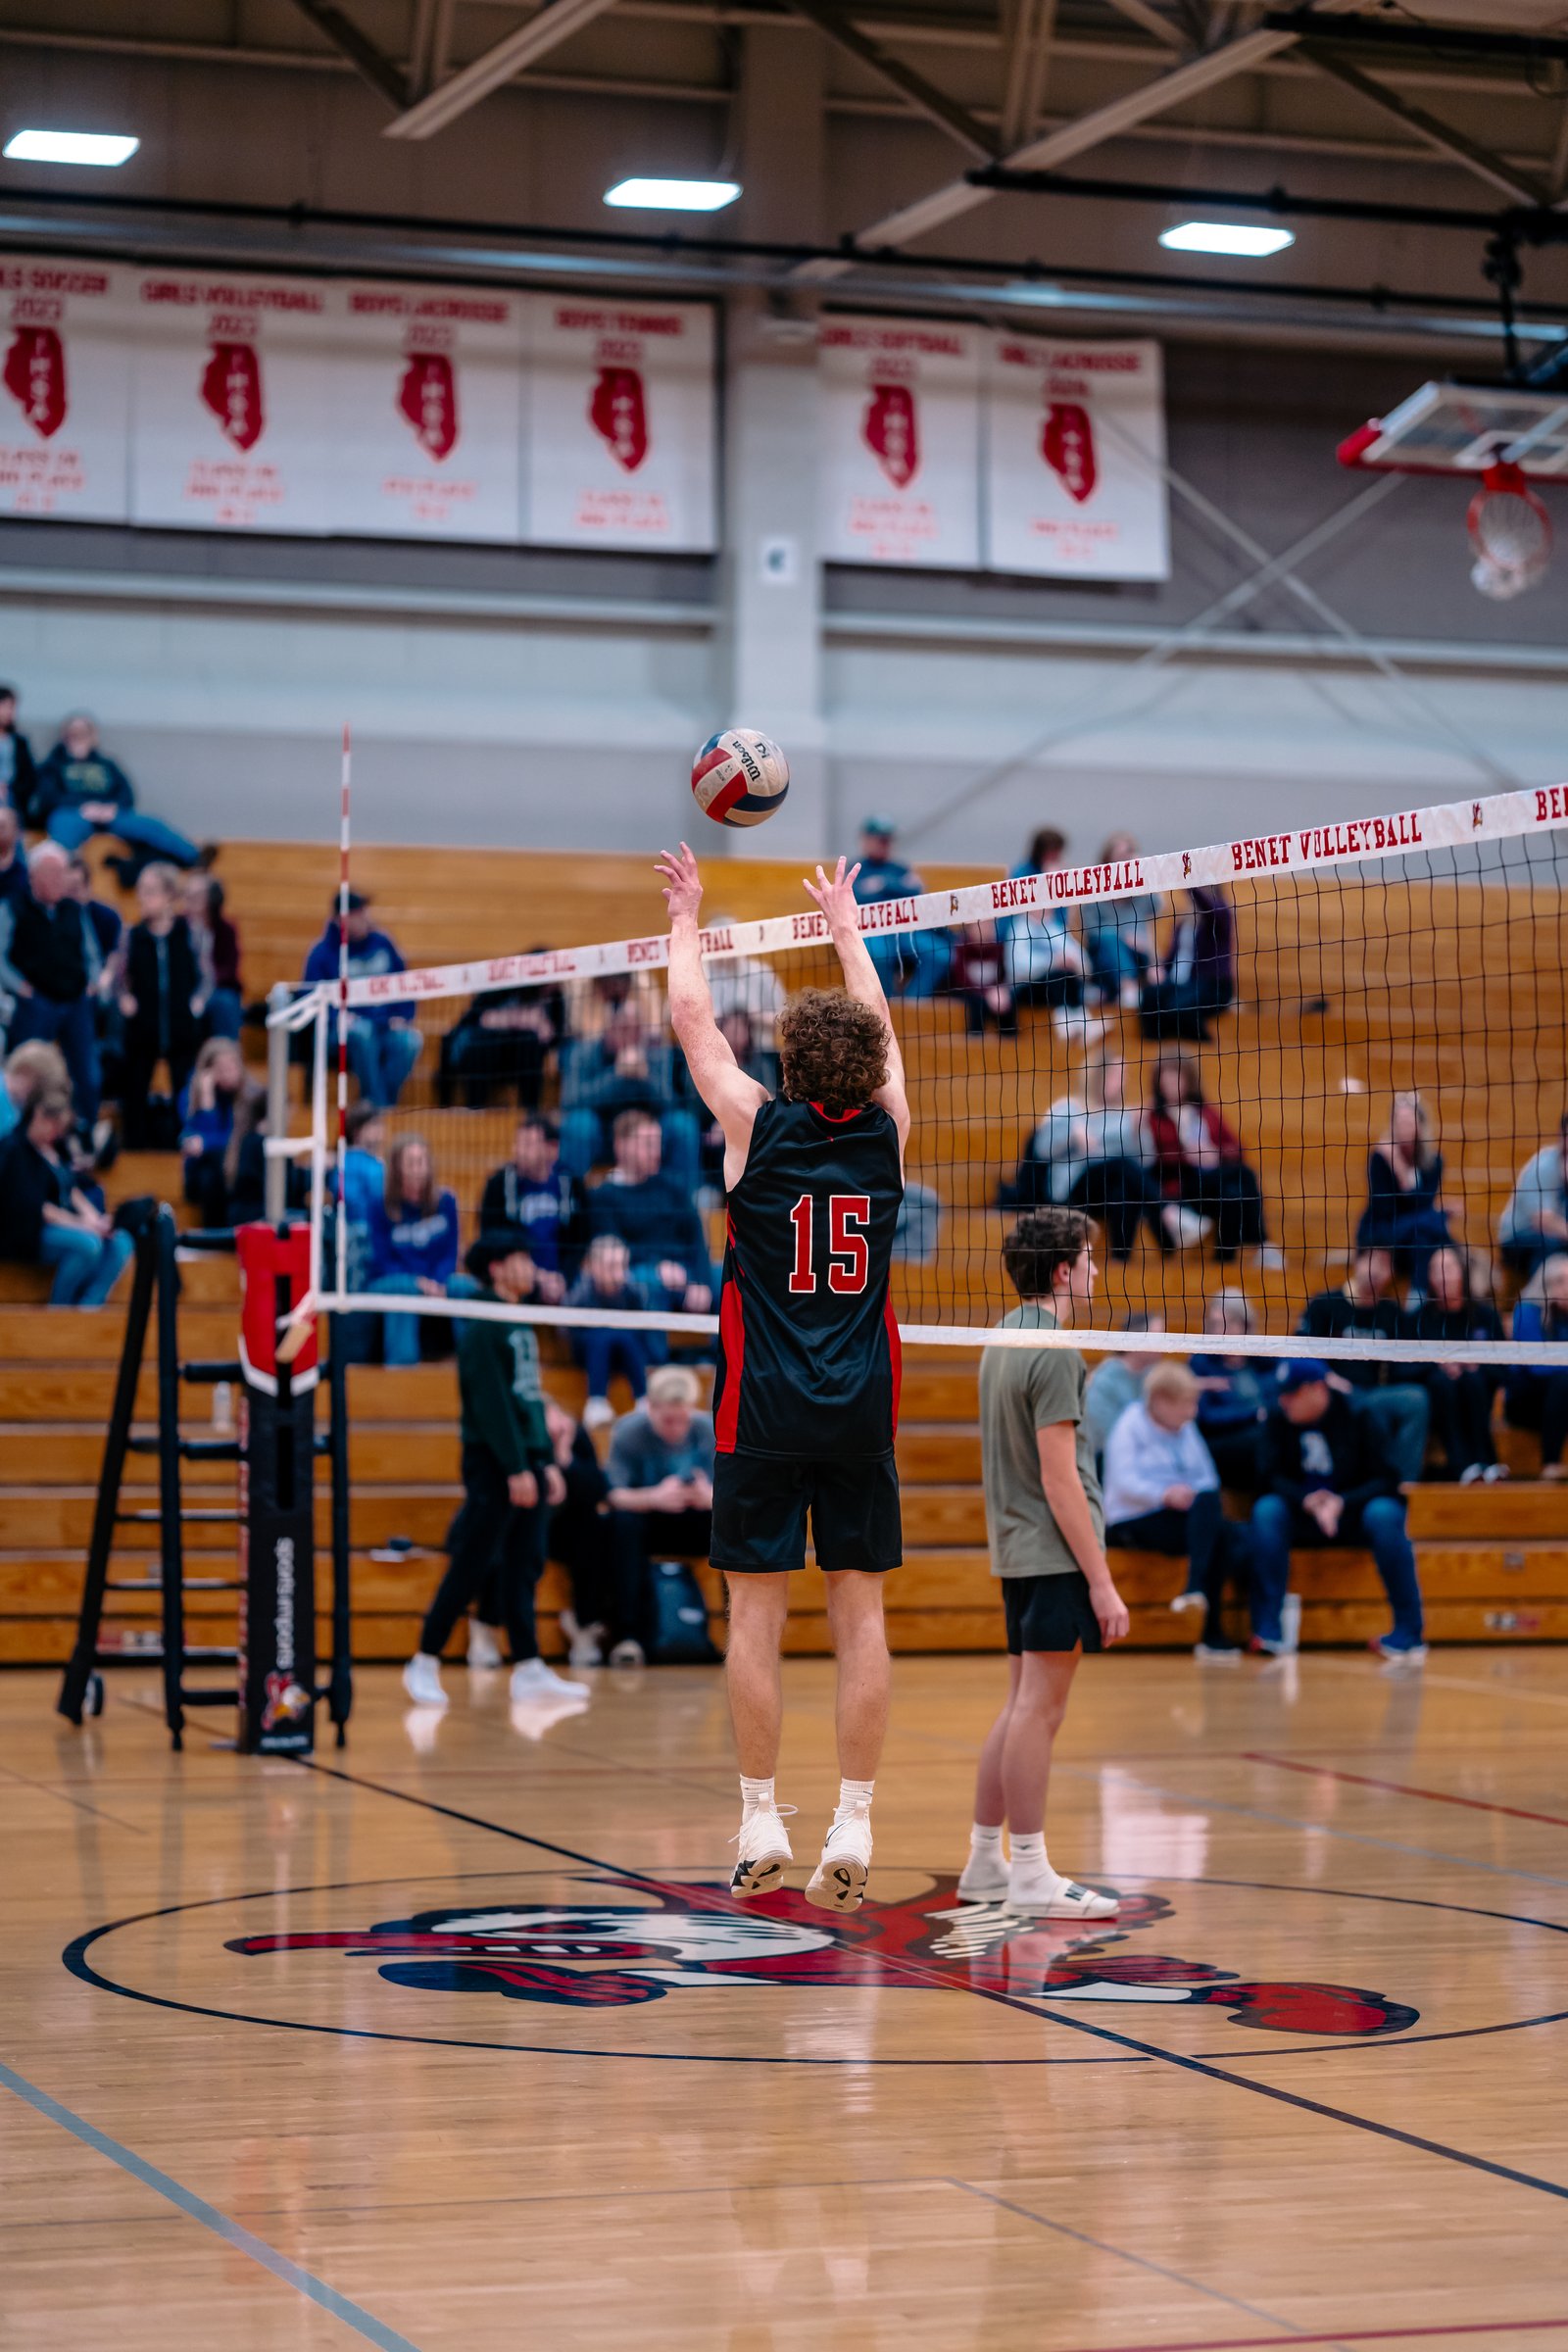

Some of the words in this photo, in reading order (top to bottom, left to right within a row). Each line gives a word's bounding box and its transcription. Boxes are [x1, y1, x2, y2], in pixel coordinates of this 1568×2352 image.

[732, 740, 760, 781] Wilson
[1231, 834, 1292, 871] BENET
[1299, 812, 1422, 860] VOLLEYBALL
[991, 877, 1037, 908] BENET
[1047, 860, 1145, 900] VOLLEYBALL
[789, 1195, 870, 1294] 15
